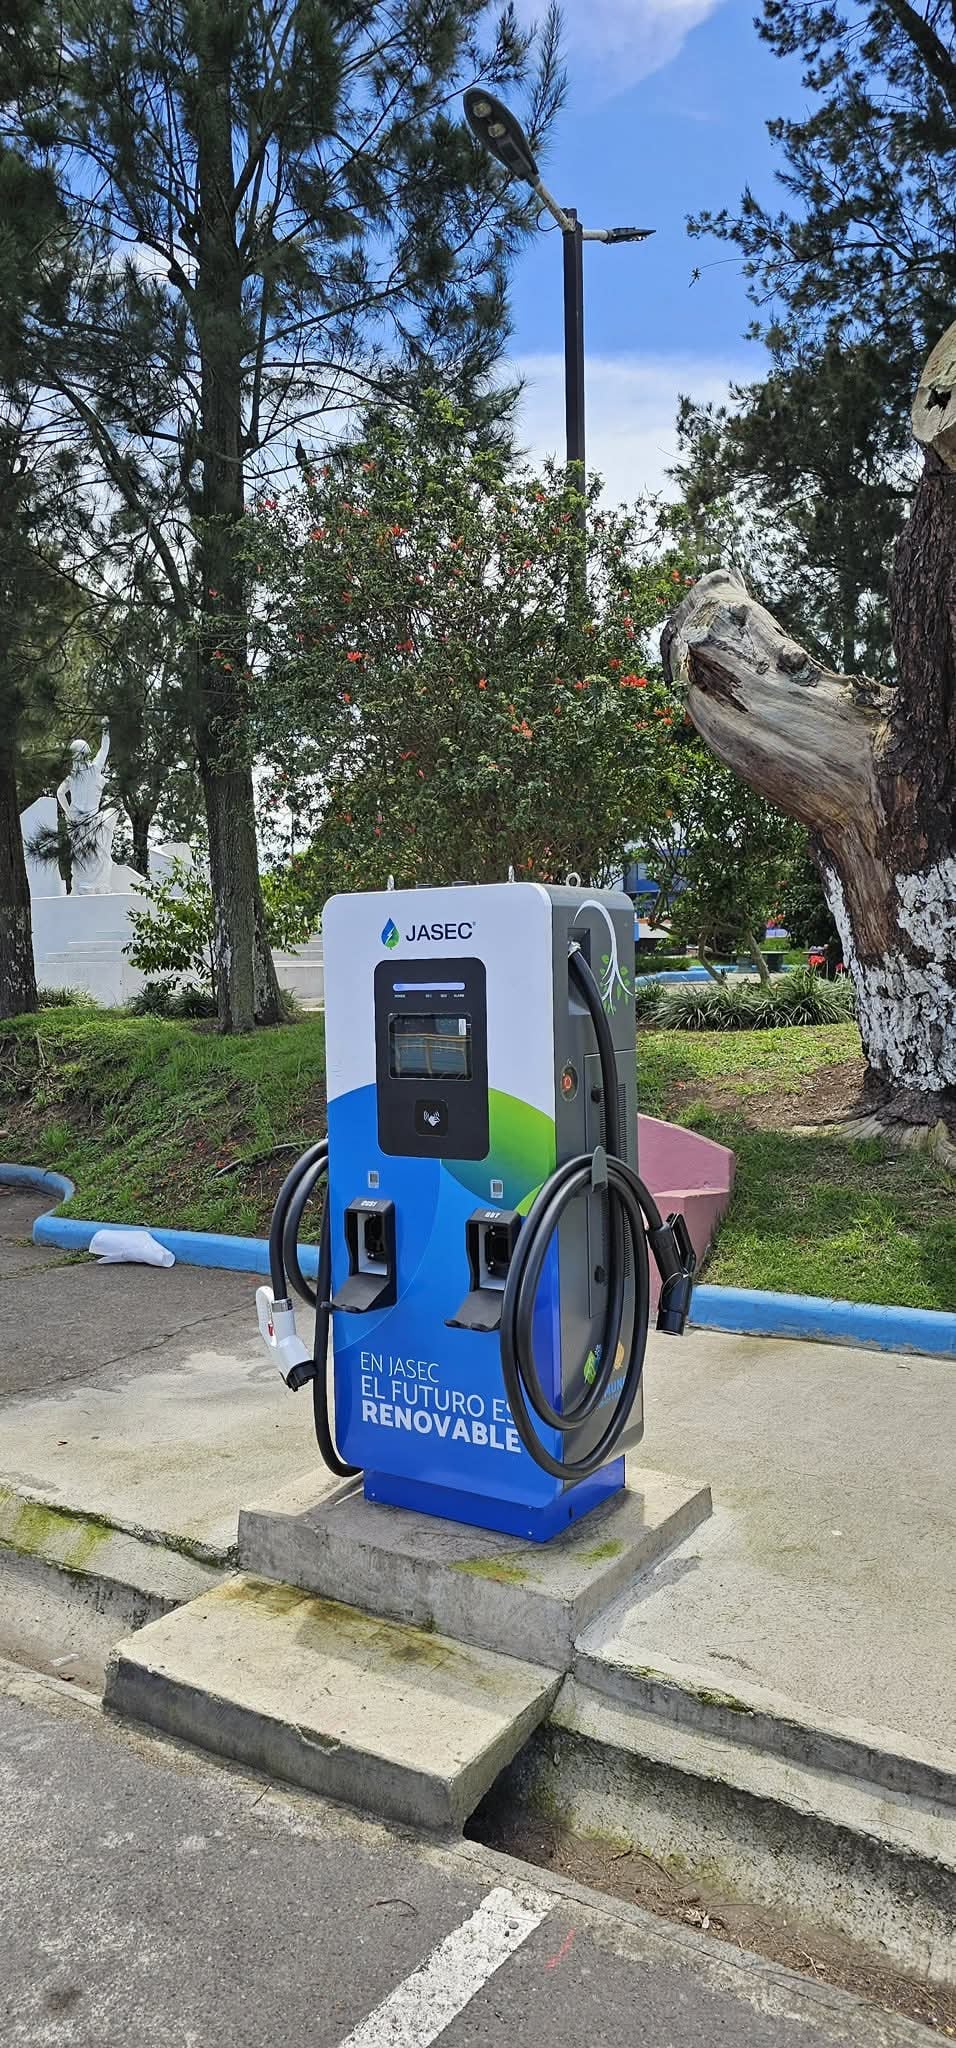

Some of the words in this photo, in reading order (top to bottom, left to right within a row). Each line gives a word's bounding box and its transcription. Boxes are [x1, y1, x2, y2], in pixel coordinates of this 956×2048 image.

[406, 923, 473, 942] JASEC
[360, 1351, 383, 1374] EN
[388, 1356, 440, 1383] JASEC
[361, 1374, 386, 1400] EL
[391, 1379, 485, 1418] FUTURO
[361, 1399, 522, 1454] RENOVABLE
